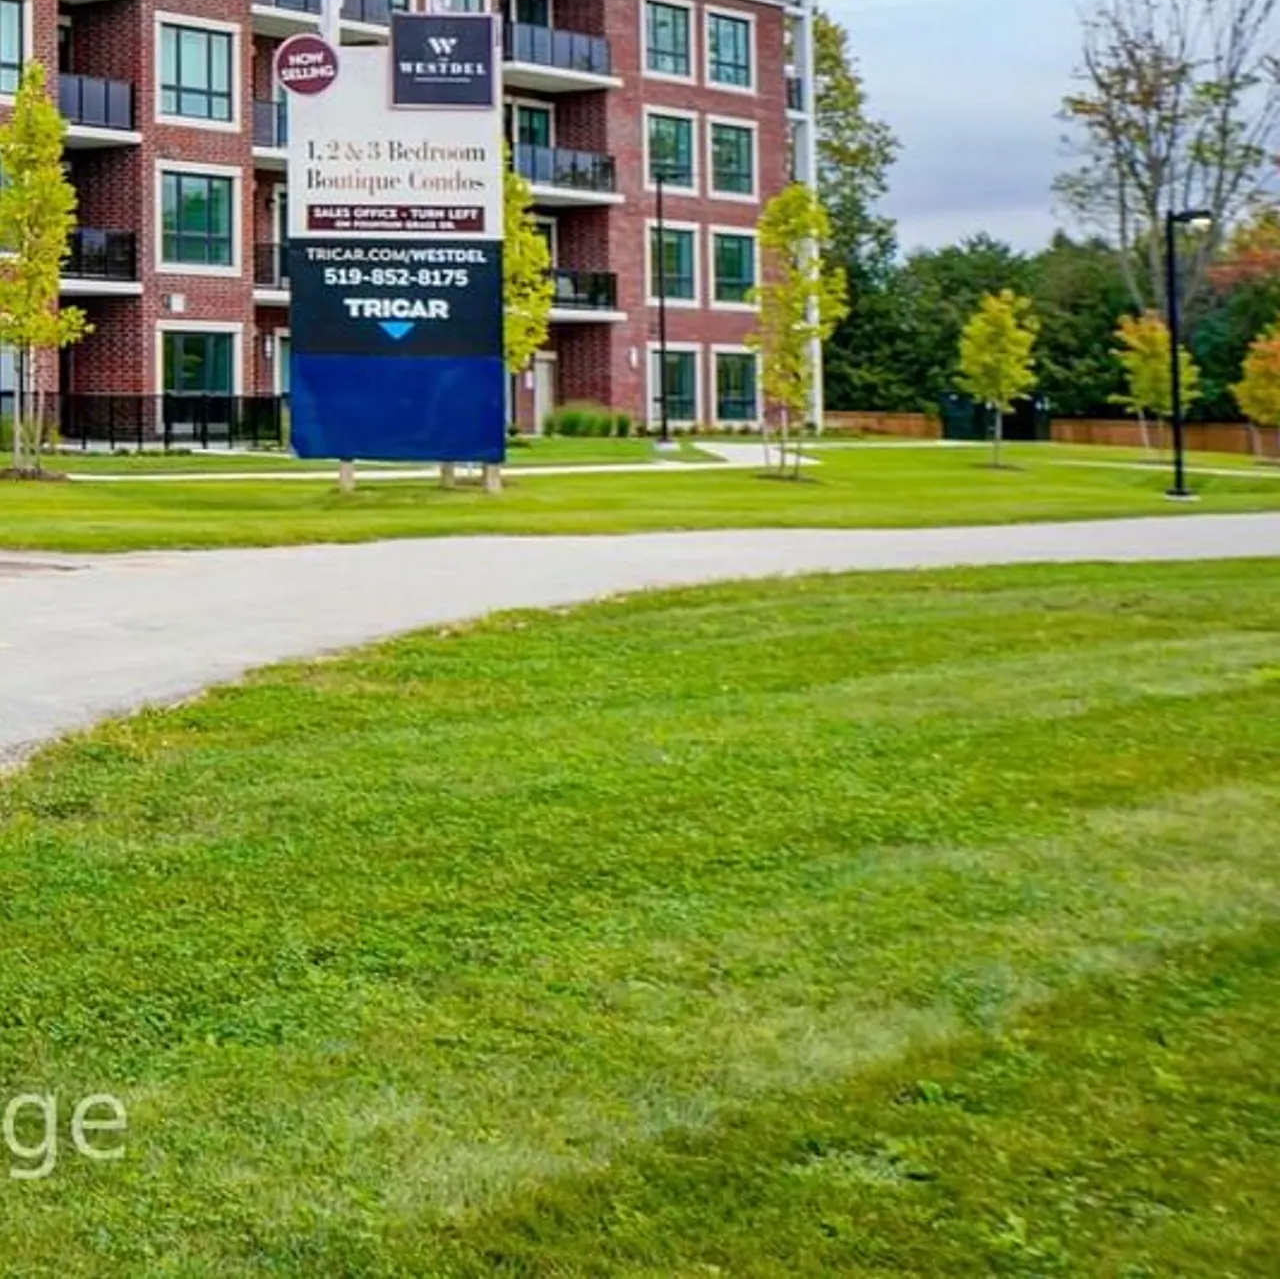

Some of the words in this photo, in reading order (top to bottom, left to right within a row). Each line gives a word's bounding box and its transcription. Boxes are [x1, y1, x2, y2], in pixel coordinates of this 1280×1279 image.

[288, 52, 324, 67] NOW
[281, 65, 336, 82] SELLING
[399, 61, 487, 76] WESTDEL
[327, 141, 340, 160] 2
[344, 142, 364, 162] &
[367, 141, 381, 160] 3
[388, 141, 486, 163] Bedroom
[307, 168, 401, 197] Boutique
[408, 171, 486, 192] Condos
[313, 207, 350, 218] SALES
[354, 208, 398, 219] OFFICE
[409, 209, 445, 220] TURN
[448, 209, 478, 220] LEFT
[306, 247, 487, 264] TRICAR.COM/WESTDEL
[324, 268, 469, 287] 519-852-8175
[344, 298, 450, 319] TRICAR
